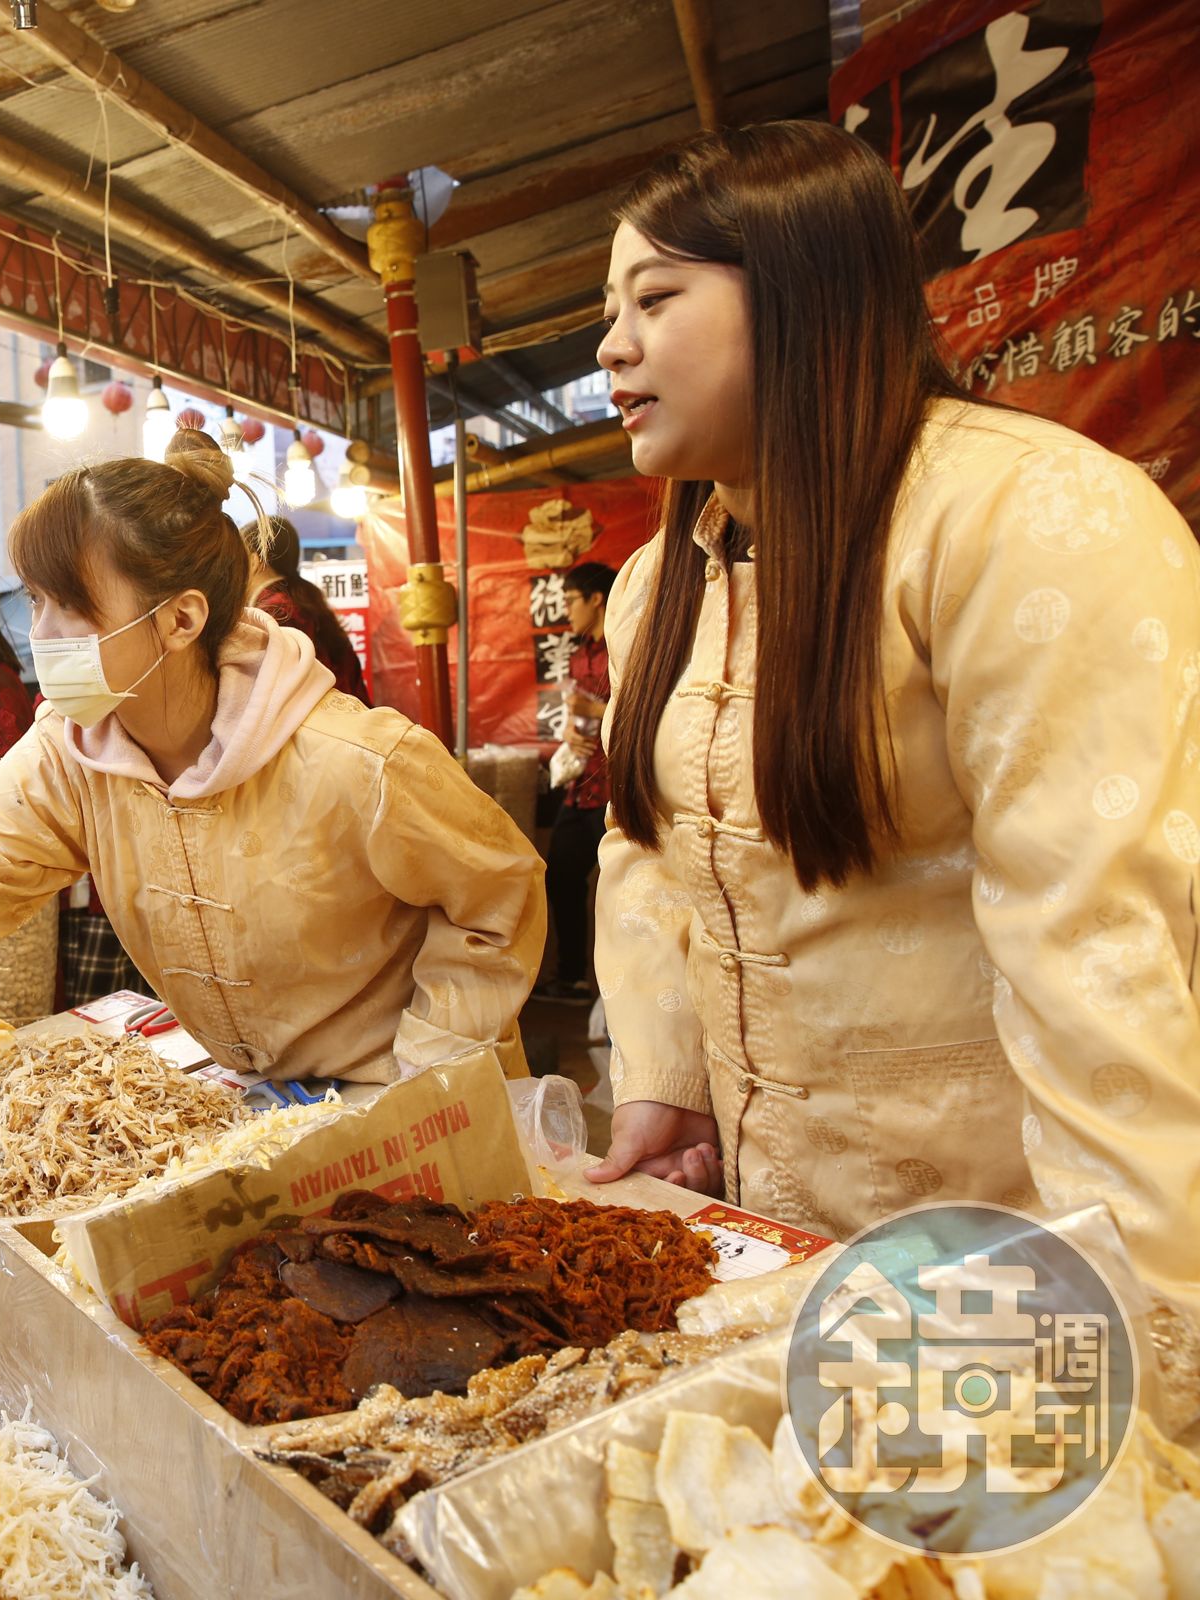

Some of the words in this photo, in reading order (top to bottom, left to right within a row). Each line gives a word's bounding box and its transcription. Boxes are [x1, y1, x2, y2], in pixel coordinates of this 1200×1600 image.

[935, 255, 1079, 328] 品牌
[382, 1131, 409, 1168] IN
[408, 1099, 472, 1154] MADE
[289, 1147, 381, 1208] TAIWAN
